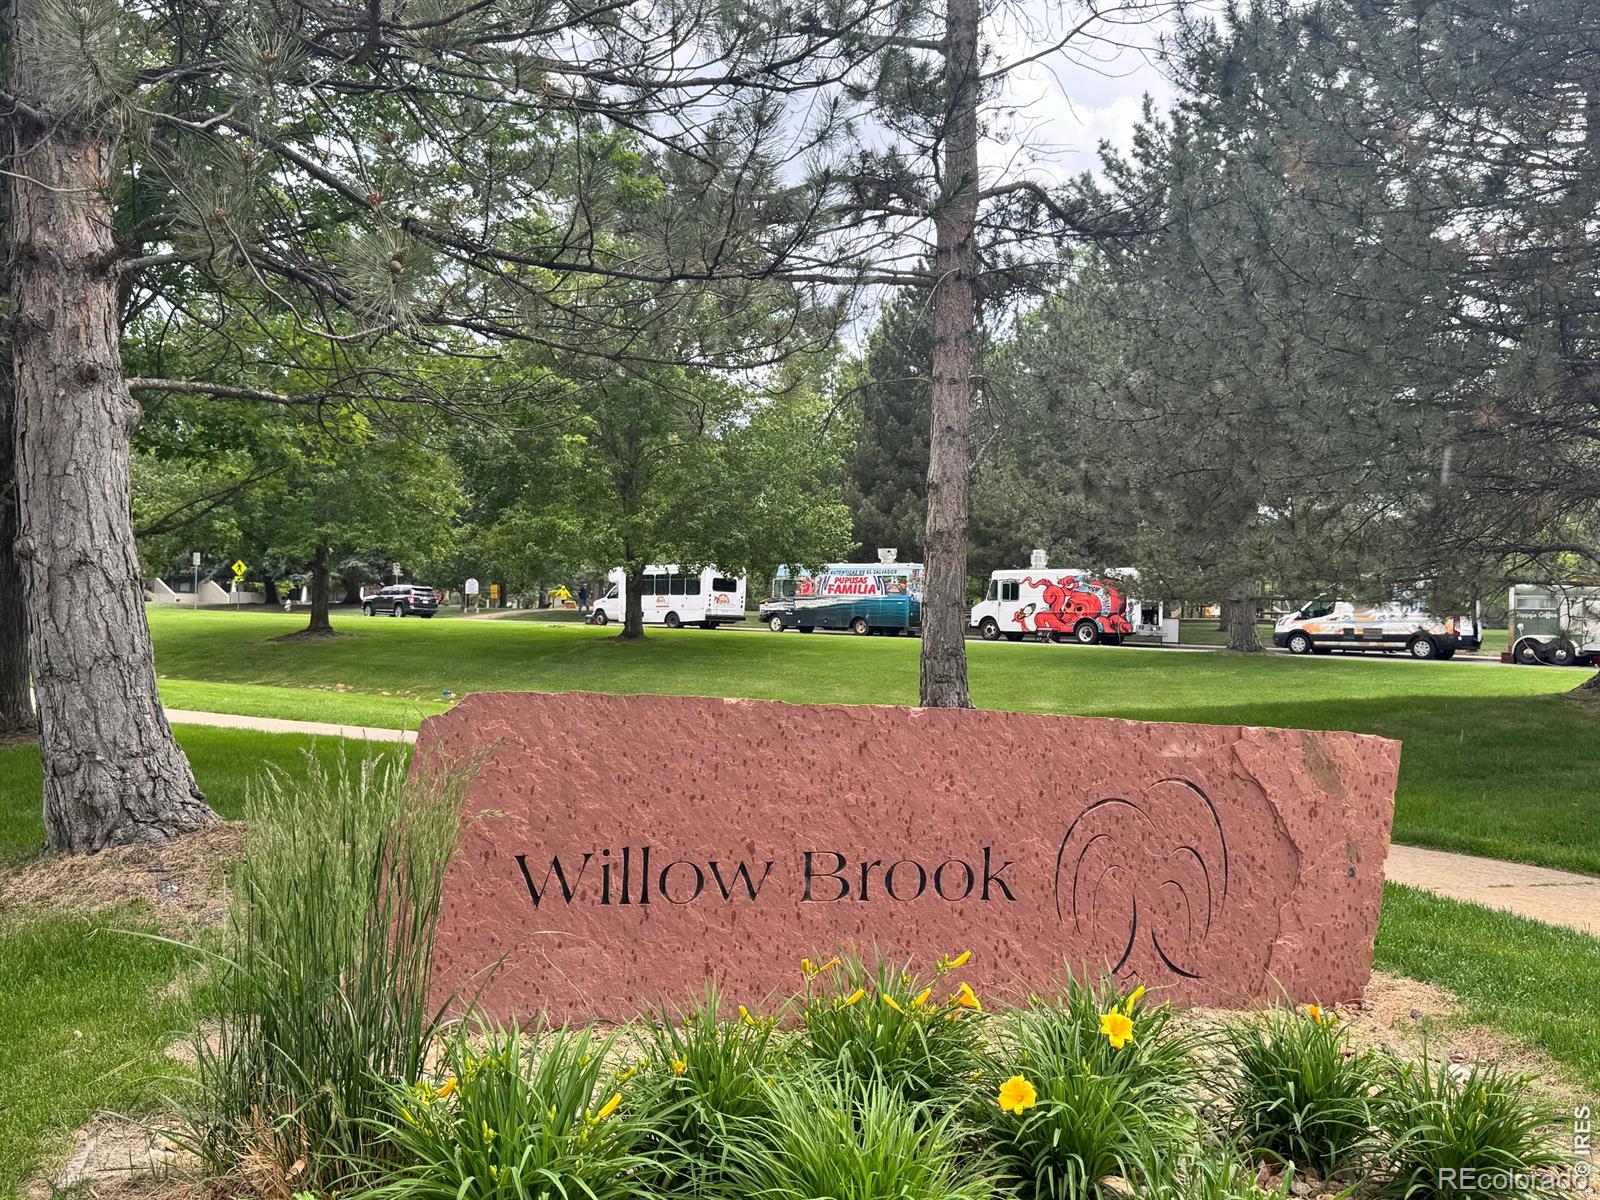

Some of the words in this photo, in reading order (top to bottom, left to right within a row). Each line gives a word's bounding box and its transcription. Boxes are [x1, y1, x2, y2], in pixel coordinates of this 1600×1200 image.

[834, 576, 868, 584] PUPUSAS
[827, 584, 876, 594] FAMILIA
[1539, 611, 1558, 619] Coffee
[514, 847, 774, 908] Willow
[800, 846, 1017, 904] Brook
